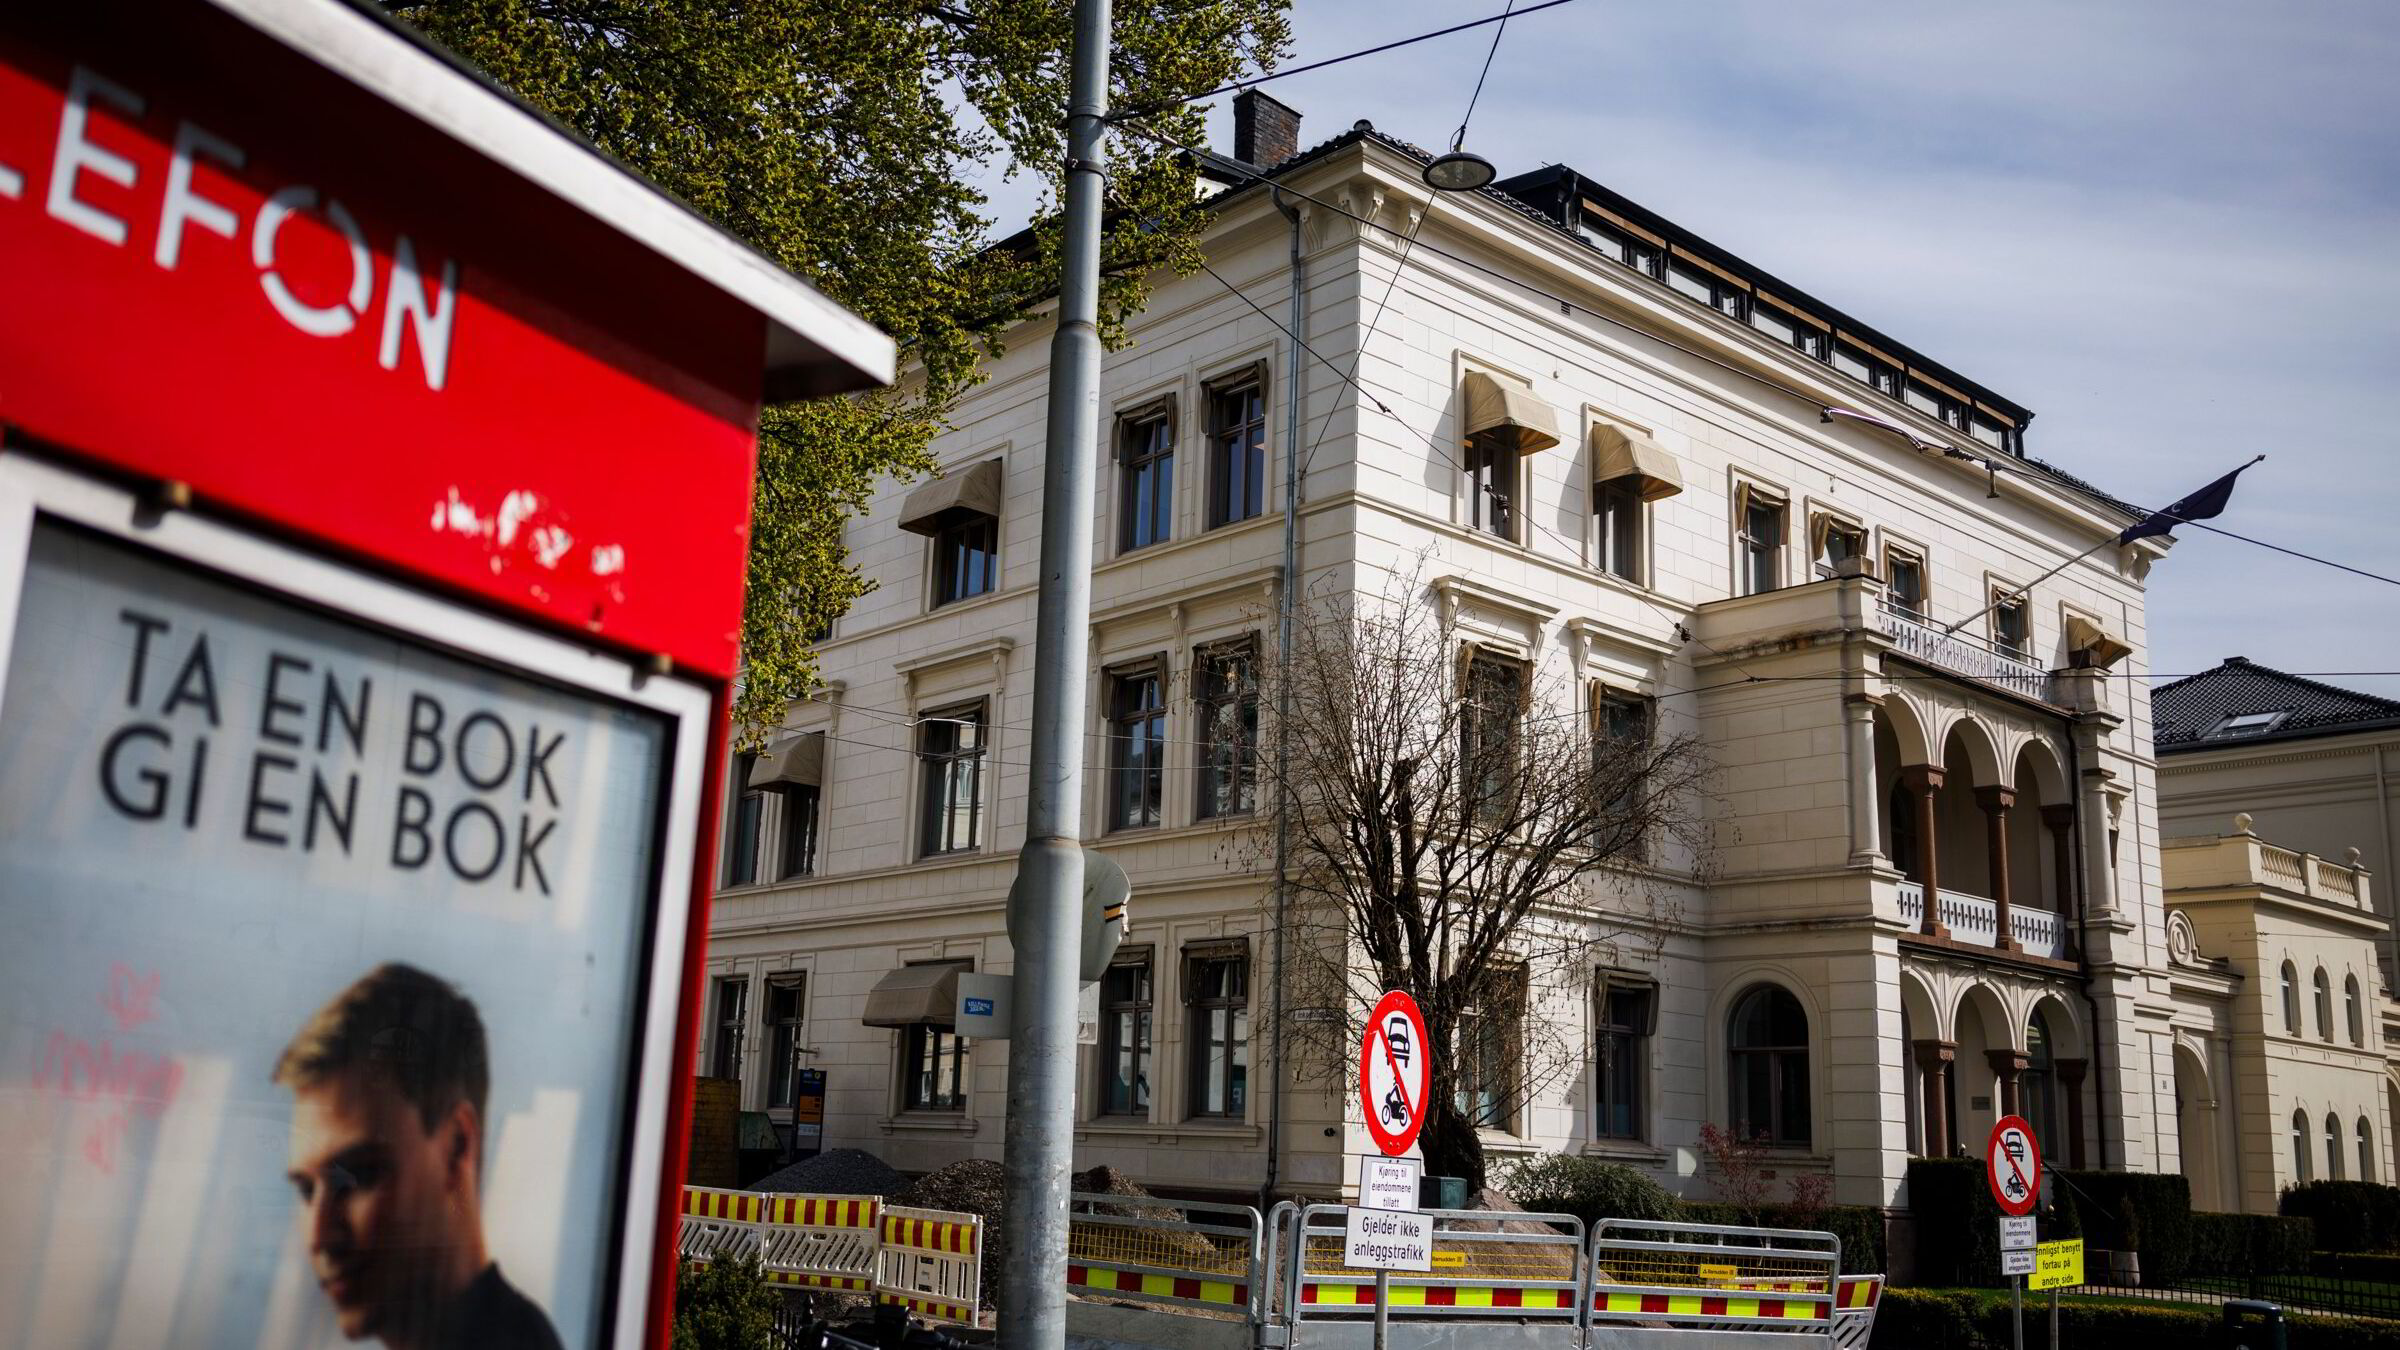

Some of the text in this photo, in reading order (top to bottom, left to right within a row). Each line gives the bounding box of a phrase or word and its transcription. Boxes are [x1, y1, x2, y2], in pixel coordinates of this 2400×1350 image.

[0, 65, 457, 392] EFON
[118, 608, 566, 809] TA EN BOK
[98, 721, 557, 896] GI EN BOK
[1378, 1165, 1399, 1180] Kjøring
[1371, 1181, 1412, 1193] eiendommene
[1382, 1197, 1400, 1208] tillatt
[1362, 1216, 1420, 1238] Gjelder ikke
[1354, 1240, 1424, 1262] anleggstrafikk
[2062, 1243, 2080, 1254] benytt
[2042, 1257, 2070, 1270] fortau på
[2041, 1273, 2074, 1286] andre side
